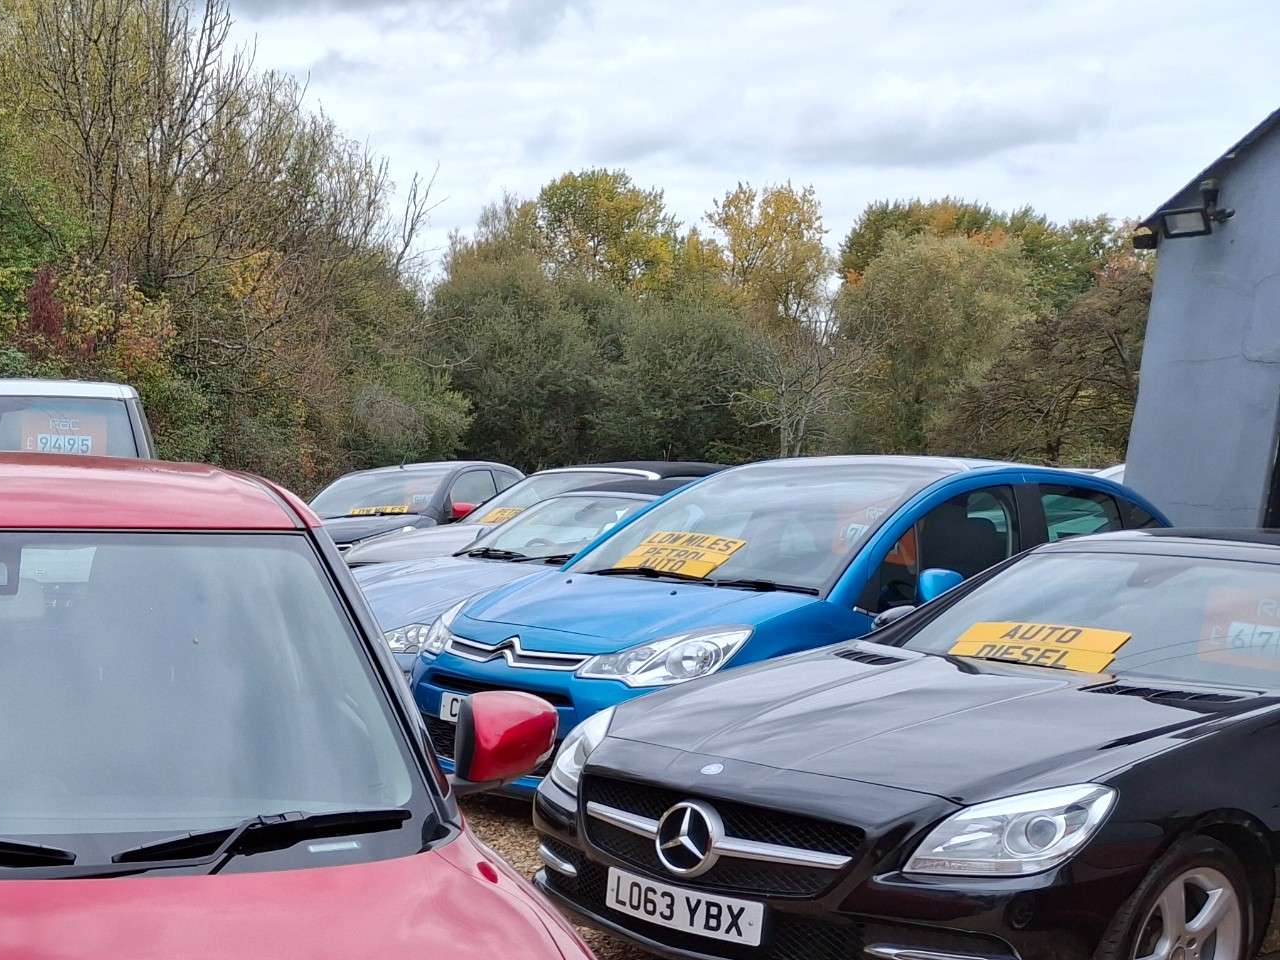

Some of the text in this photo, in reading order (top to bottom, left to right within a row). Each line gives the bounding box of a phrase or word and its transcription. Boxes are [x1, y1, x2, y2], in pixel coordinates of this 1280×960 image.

[648, 532, 737, 551] LOW MILES
[999, 624, 1082, 644] AUTO
[975, 644, 1069, 668] DIESEL
[615, 875, 745, 937] LO63 YBX
